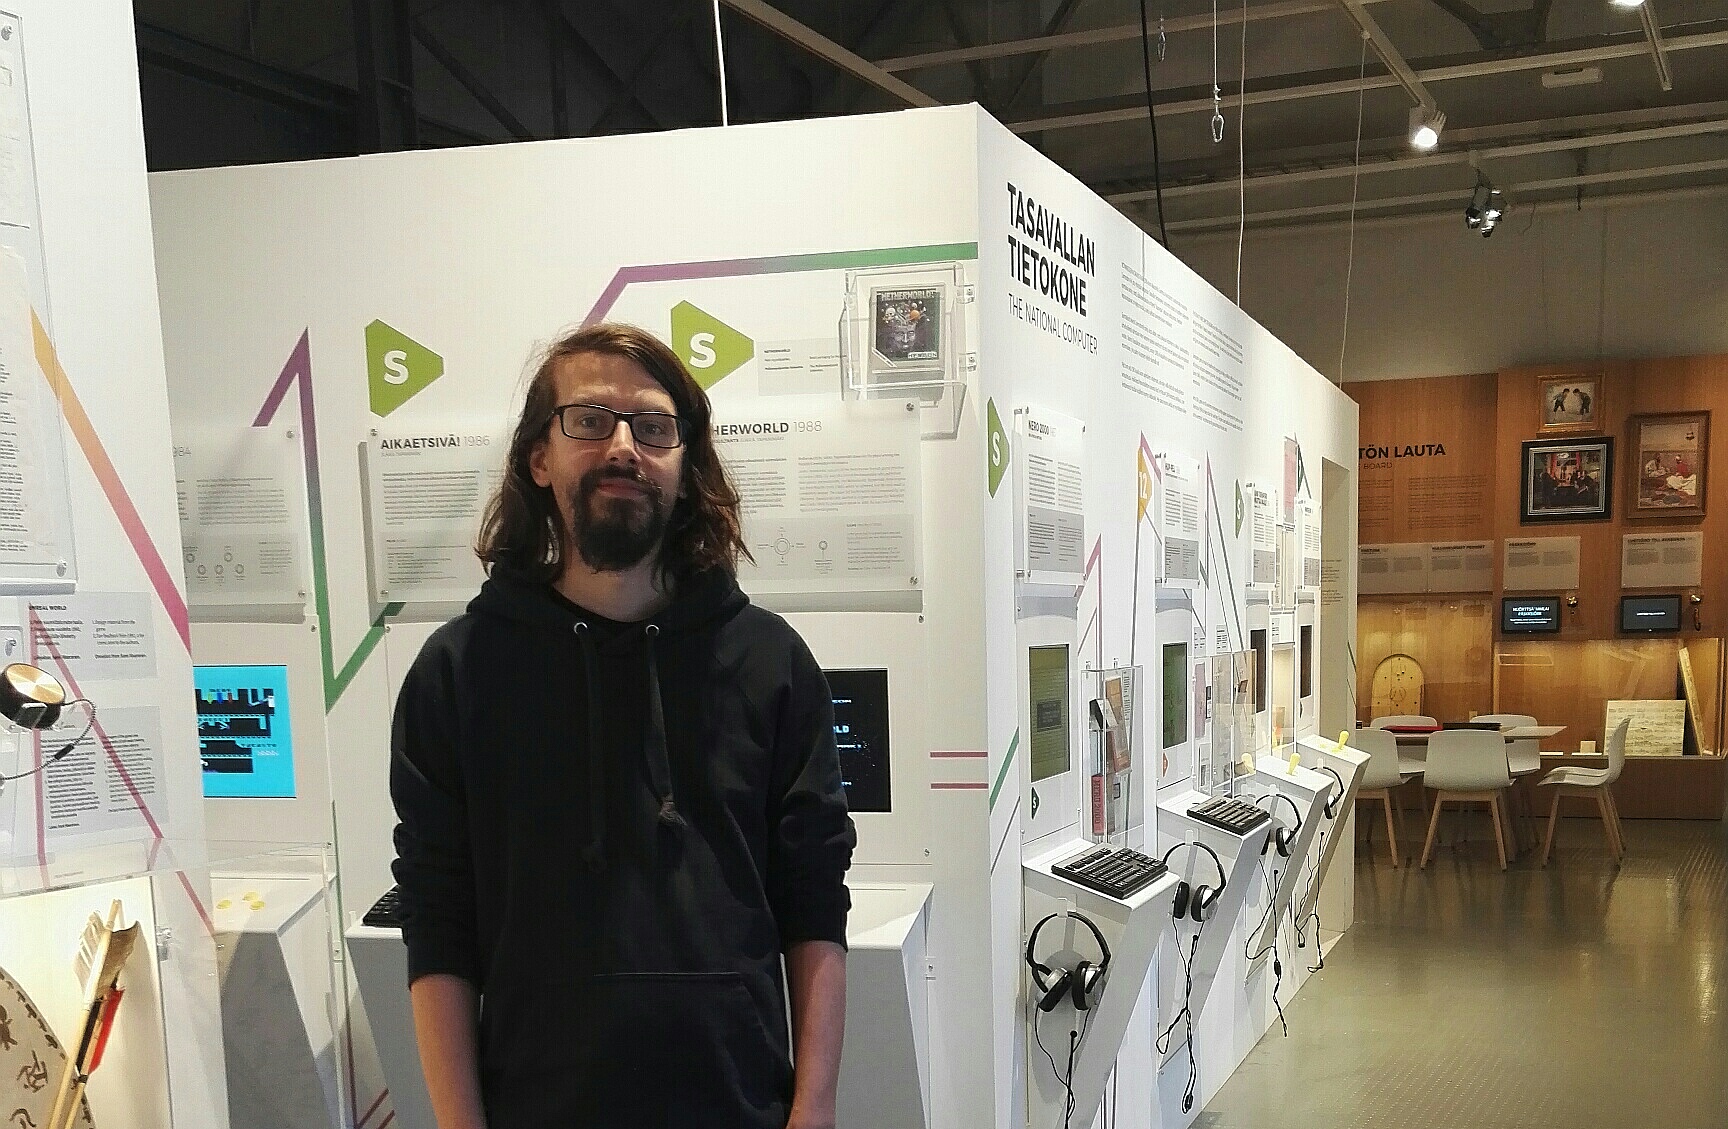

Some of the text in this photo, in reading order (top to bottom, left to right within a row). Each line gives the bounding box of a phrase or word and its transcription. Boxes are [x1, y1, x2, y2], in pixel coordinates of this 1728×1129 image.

[1007, 181, 1095, 277] TASAVALLAN
[1007, 234, 1087, 317] TIETOKONE
[1008, 293, 1098, 356] THE NATIONAL COMPUTER
[383, 350, 409, 385] S
[688, 332, 717, 369] S
[380, 434, 490, 450] AIKAETSIVÄ! 1986
[713, 420, 823, 436] HERWORLD 1988
[992, 431, 1001, 467] S
[1358, 443, 1446, 459] TÖN LAUTA
[1363, 462, 1393, 470] BOARD
